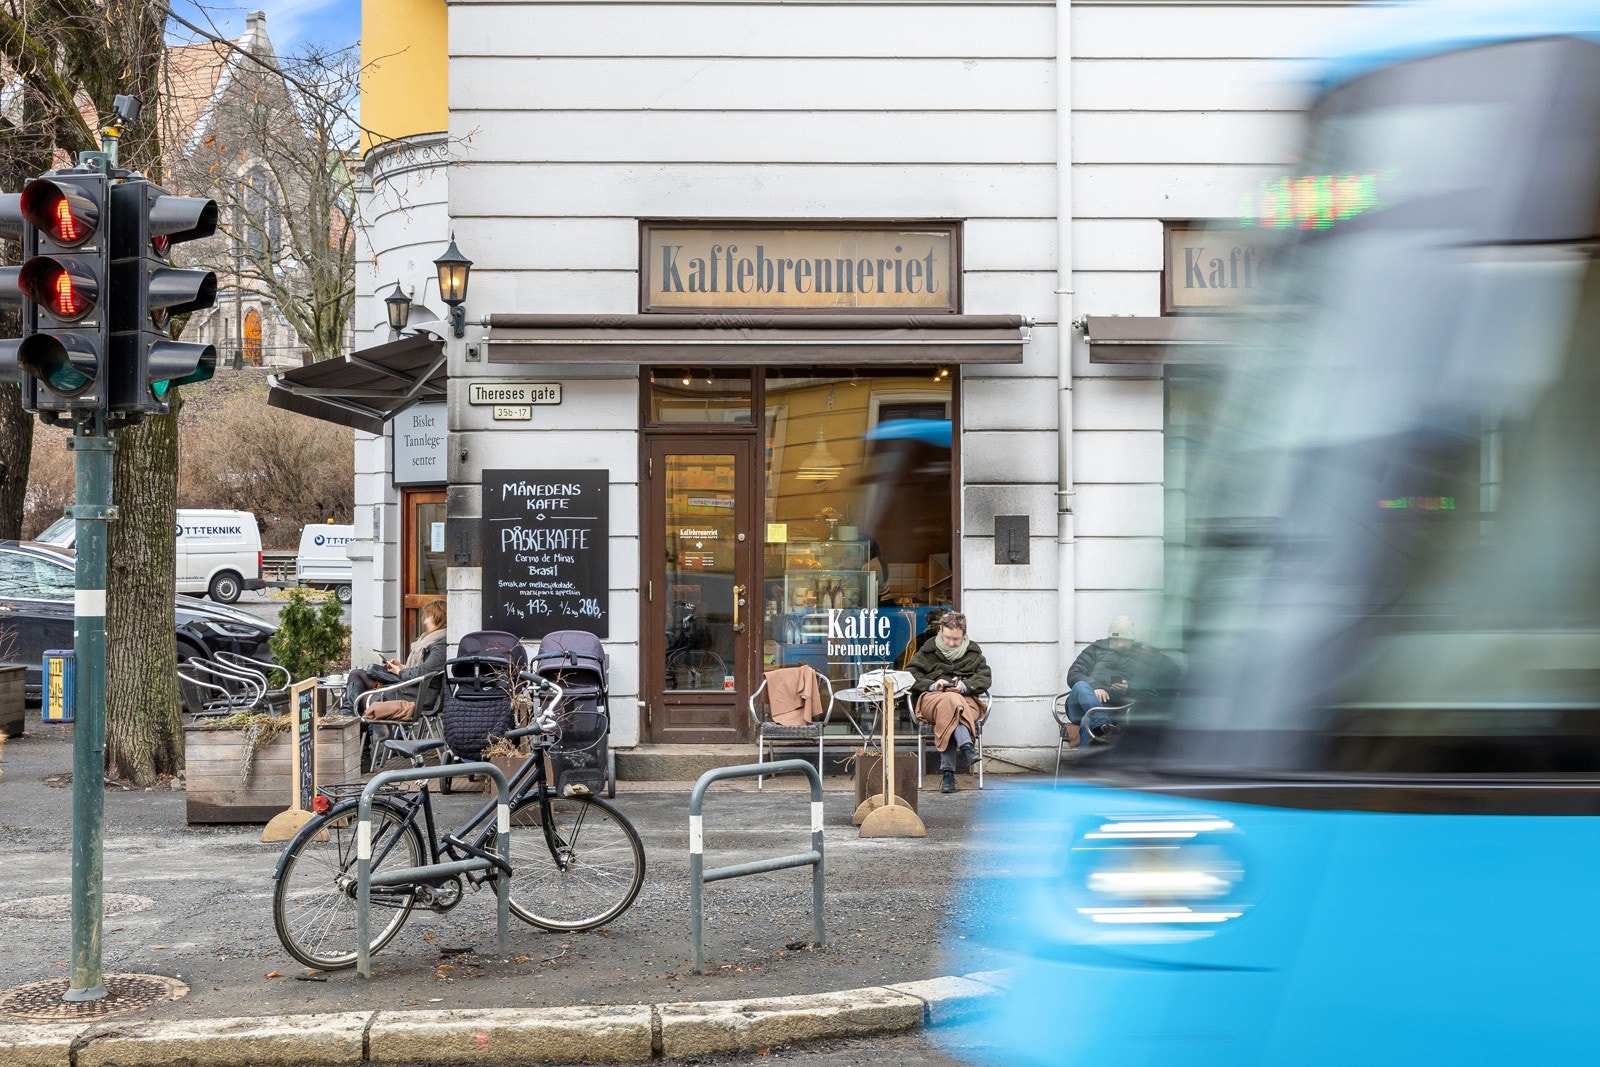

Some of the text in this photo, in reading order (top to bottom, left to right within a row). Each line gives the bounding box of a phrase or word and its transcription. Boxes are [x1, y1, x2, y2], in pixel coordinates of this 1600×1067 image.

[660, 244, 940, 294] Kaffebrenneriet
[475, 386, 555, 402] Thereses gate
[413, 415, 435, 428] Bislet
[404, 434, 445, 449] Tannlege-
[412, 456, 436, 466] senter
[502, 481, 581, 501] MÅNEDENS
[526, 499, 570, 510] KAFFE
[184, 526, 242, 535] TT-TEKNIKK
[501, 525, 591, 552] PÅSKEKAFFE
[515, 553, 575, 564] Carmo de Minas
[528, 564, 558, 576] Brasil
[498, 580, 518, 588] Smak
[517, 608, 525, 619] kg
[572, 609, 579, 618] kg
[827, 608, 891, 639] Kaffe
[827, 640, 891, 656] brenneriet
